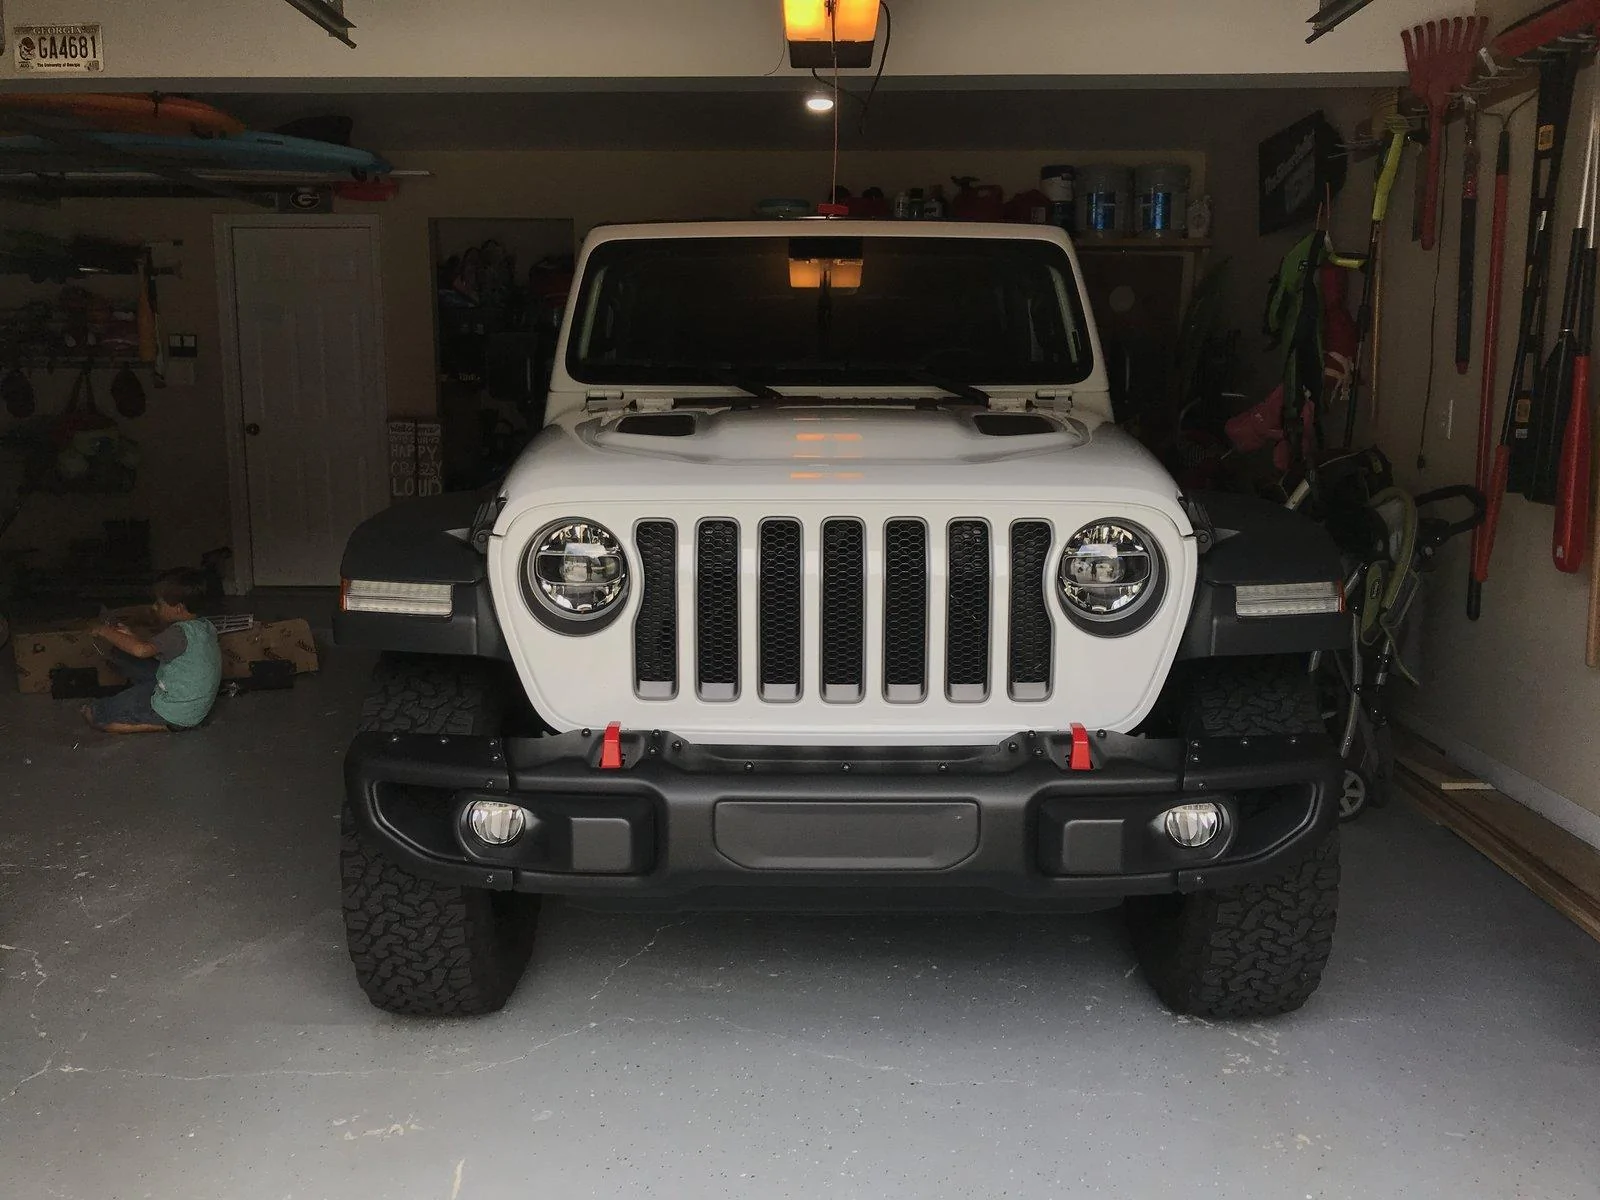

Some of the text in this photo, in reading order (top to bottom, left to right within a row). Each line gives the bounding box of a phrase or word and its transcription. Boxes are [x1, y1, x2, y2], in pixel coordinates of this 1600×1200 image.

[32, 25, 82, 35] GEORGIA
[38, 35, 97, 59] GA4681
[390, 444, 437, 460] HAPPY
[392, 477, 443, 497] LOUD
